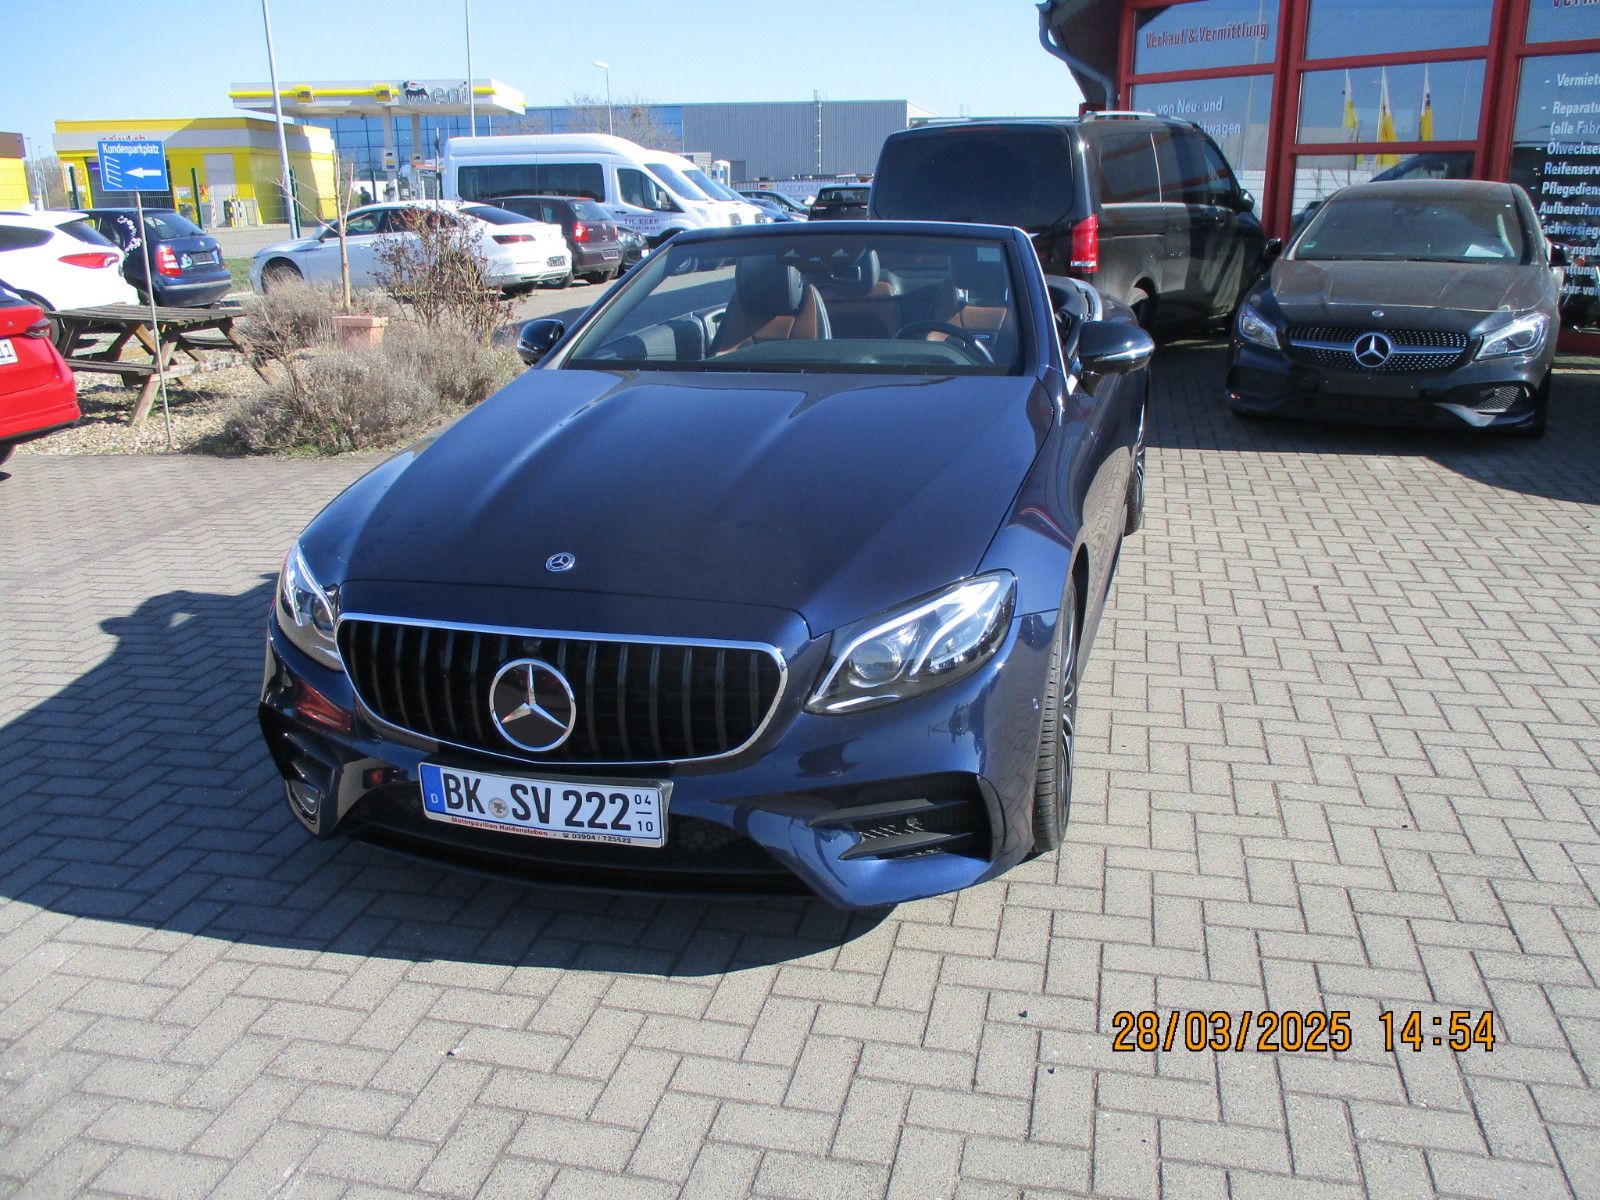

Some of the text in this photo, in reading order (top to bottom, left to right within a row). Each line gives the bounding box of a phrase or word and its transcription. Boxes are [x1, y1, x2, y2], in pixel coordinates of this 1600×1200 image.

[1146, 22, 1268, 48] Verkauf & Vermittlung
[1557, 72, 1600, 87] Vermiet
[1157, 103, 1175, 115] von
[1203, 97, 1223, 112] und
[102, 143, 160, 156] Kundenparkplatz
[430, 793, 439, 804] D
[443, 773, 631, 831] BK SV 222
[634, 794, 652, 805] 04
[637, 820, 654, 832] 10
